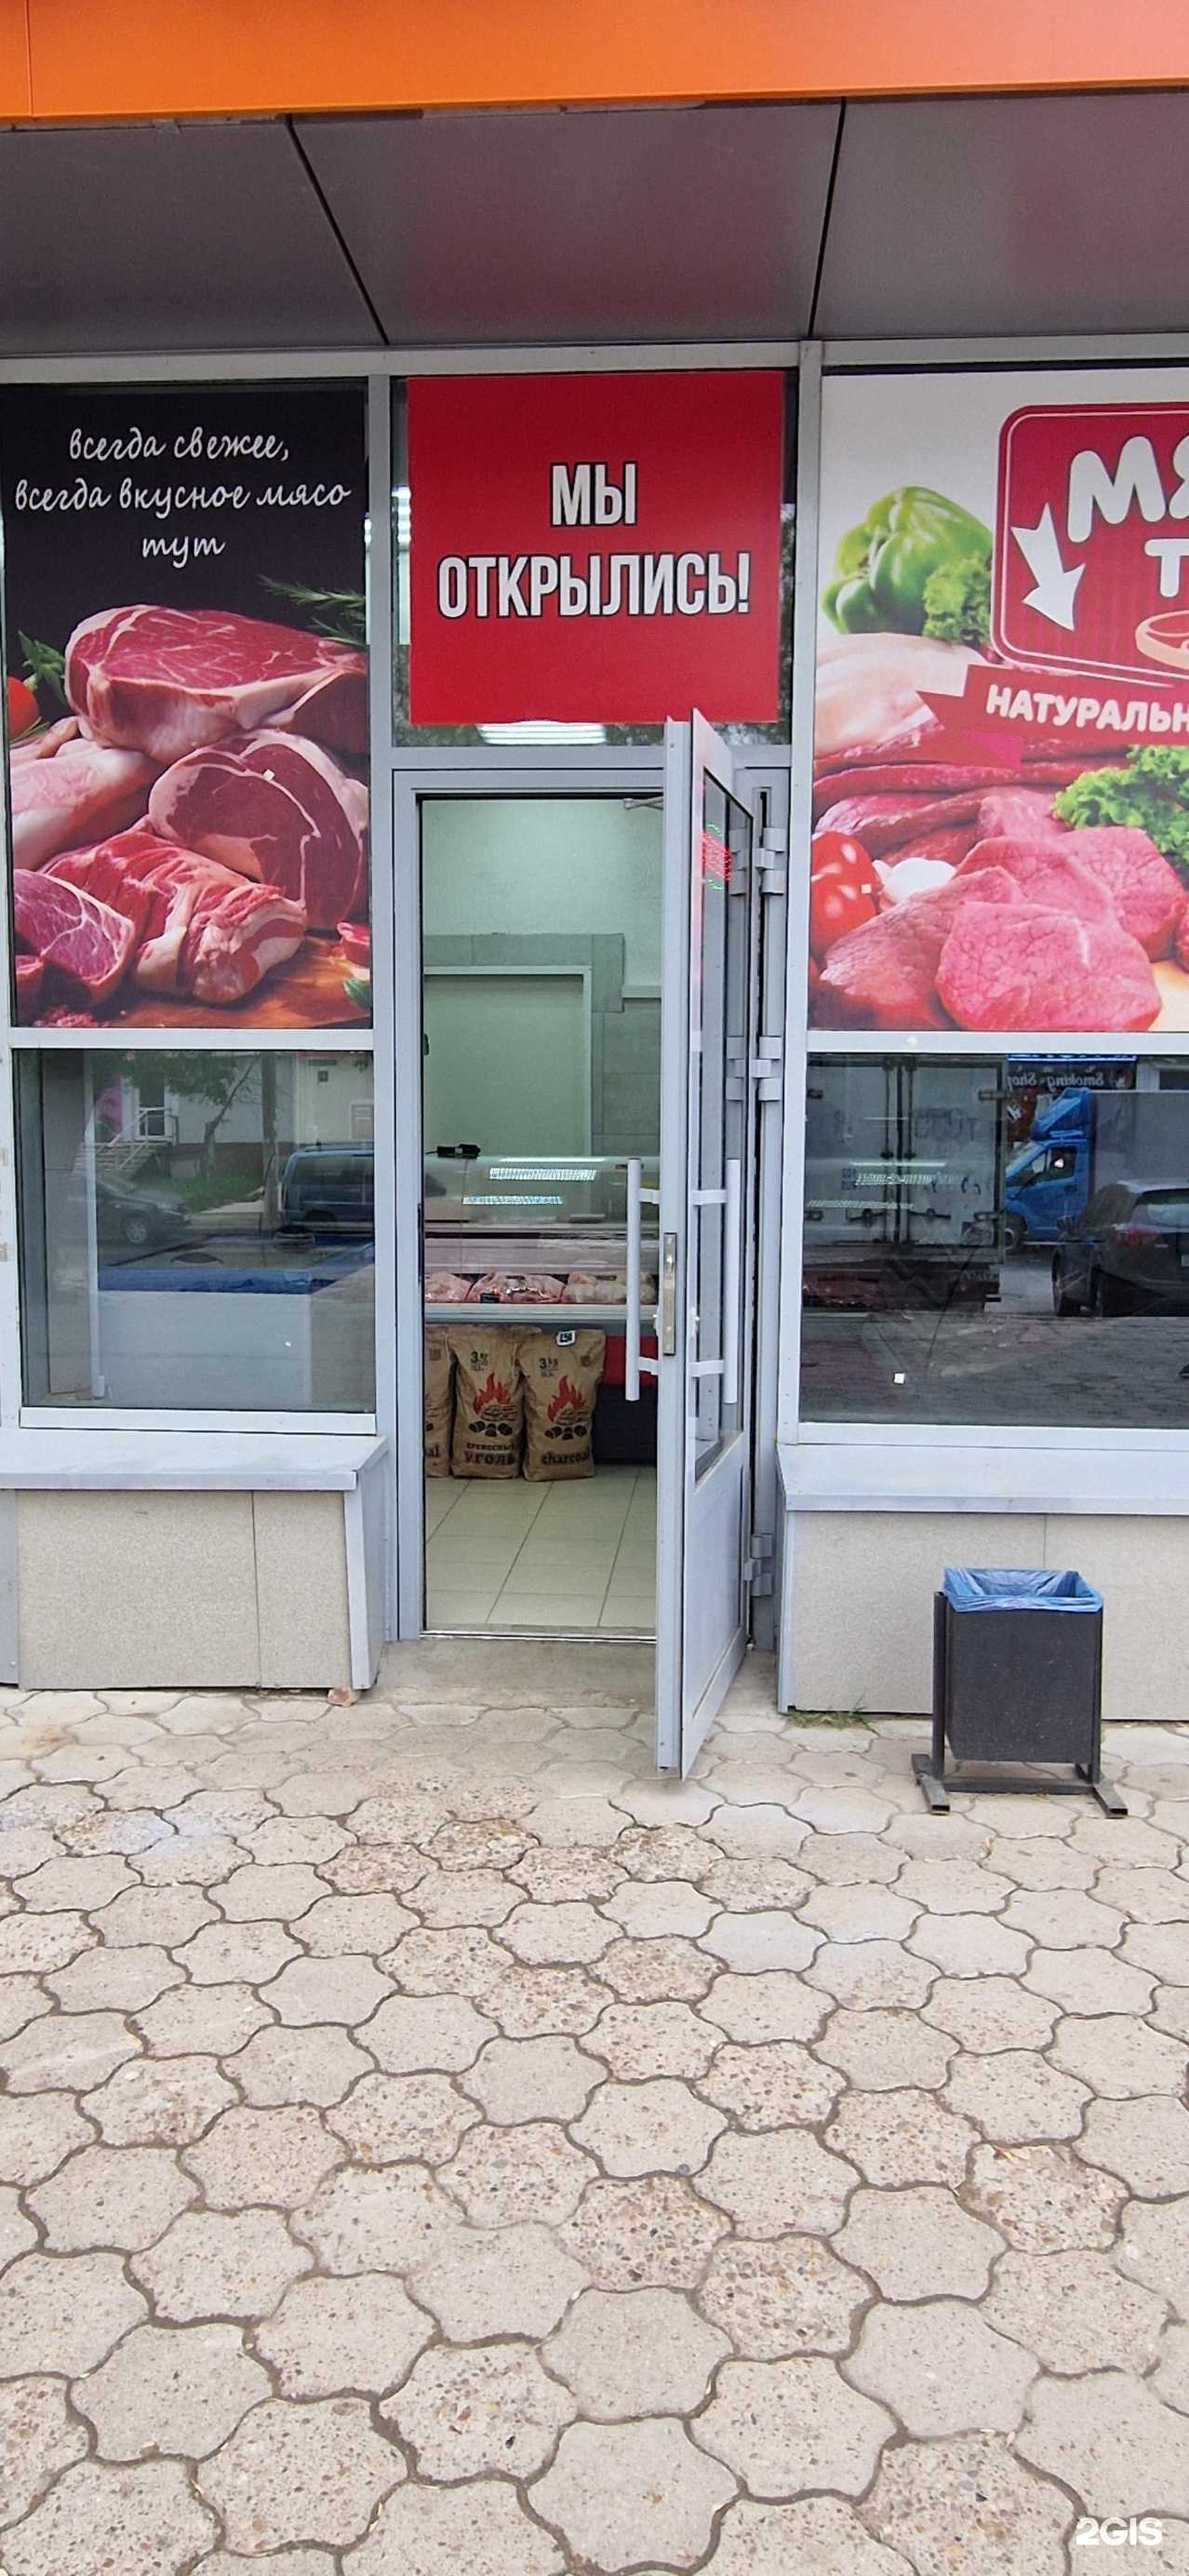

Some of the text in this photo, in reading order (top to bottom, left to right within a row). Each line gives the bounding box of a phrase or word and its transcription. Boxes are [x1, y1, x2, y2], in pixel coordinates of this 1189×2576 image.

[69, 426, 289, 462] всегда свежее,
[15, 476, 353, 518] всегда вкусное мясо
[550, 463, 637, 526] МЫ
[141, 535, 226, 569] тут
[437, 552, 751, 619] ОТКРЫЛИСЬ!
